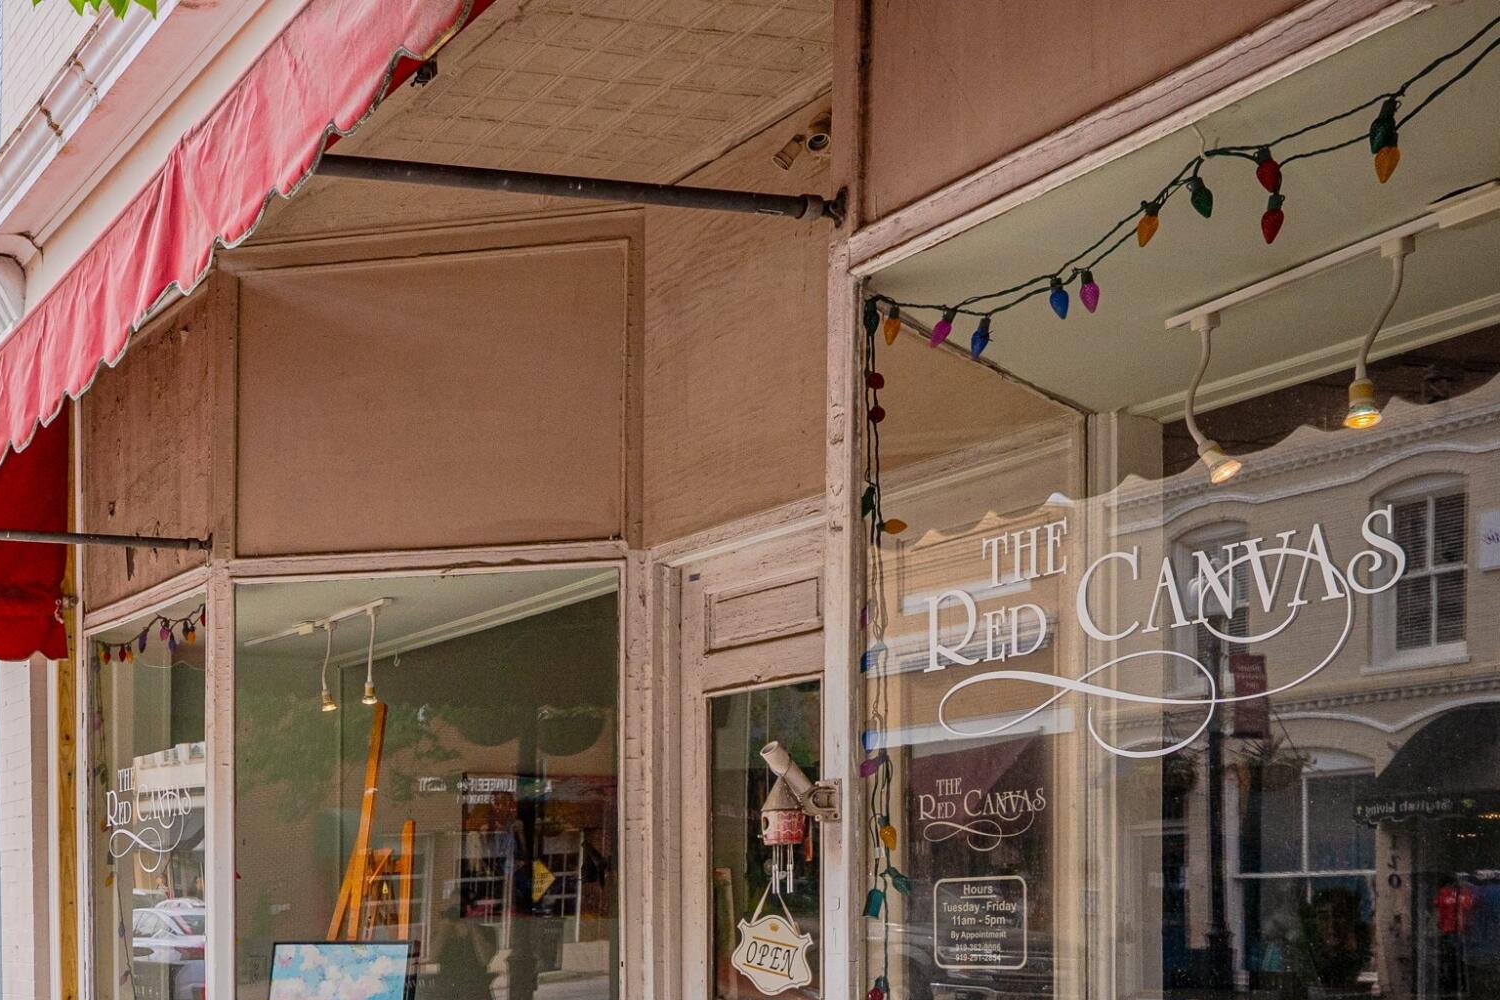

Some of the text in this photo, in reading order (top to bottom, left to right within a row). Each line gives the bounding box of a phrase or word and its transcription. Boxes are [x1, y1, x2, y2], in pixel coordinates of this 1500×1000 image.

[982, 516, 1067, 588] THE
[924, 504, 1406, 673] RED CANVAS
[936, 777, 962, 796] THE
[106, 790, 132, 827] RED
[918, 787, 1046, 820] RED CANVAS
[963, 884, 993, 895] Hours
[942, 902, 980, 914] Tuesday
[986, 901, 1017, 913] Friday
[952, 915, 976, 925] 11am
[985, 915, 1006, 927] 5pm
[951, 930, 1007, 940] By Appointment
[746, 941, 799, 980] OPEN
